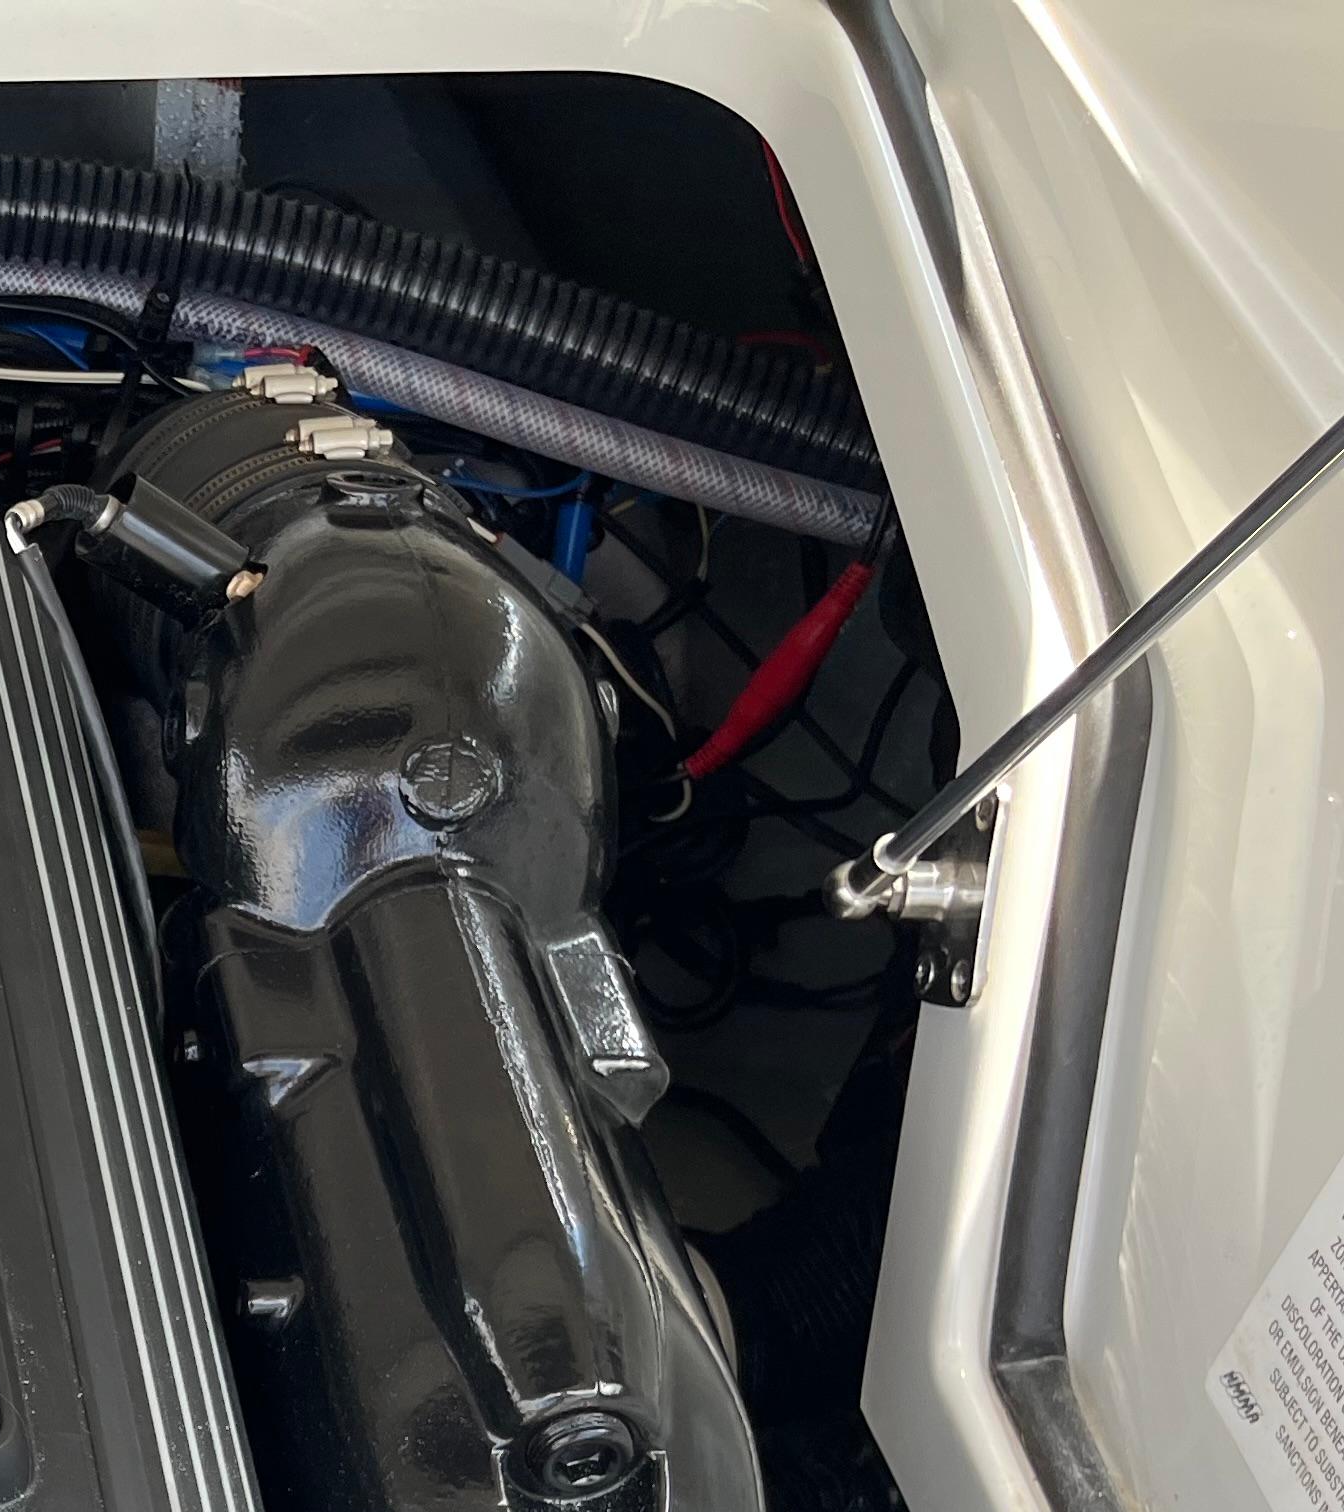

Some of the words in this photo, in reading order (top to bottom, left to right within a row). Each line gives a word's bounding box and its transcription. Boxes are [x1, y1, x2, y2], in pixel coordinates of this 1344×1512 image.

[1281, 1294, 1344, 1405] DISCOLORATION
[1310, 1297, 1326, 1318] OF
[1322, 1314, 1342, 1349] THE
[1269, 1320, 1284, 1346] OR
[1280, 1340, 1324, 1415] EMULSION
[1269, 1368, 1308, 1431] SUBJECT
[1303, 1427, 1319, 1452] TO
[1275, 1425, 1322, 1505] SANCTIONS
